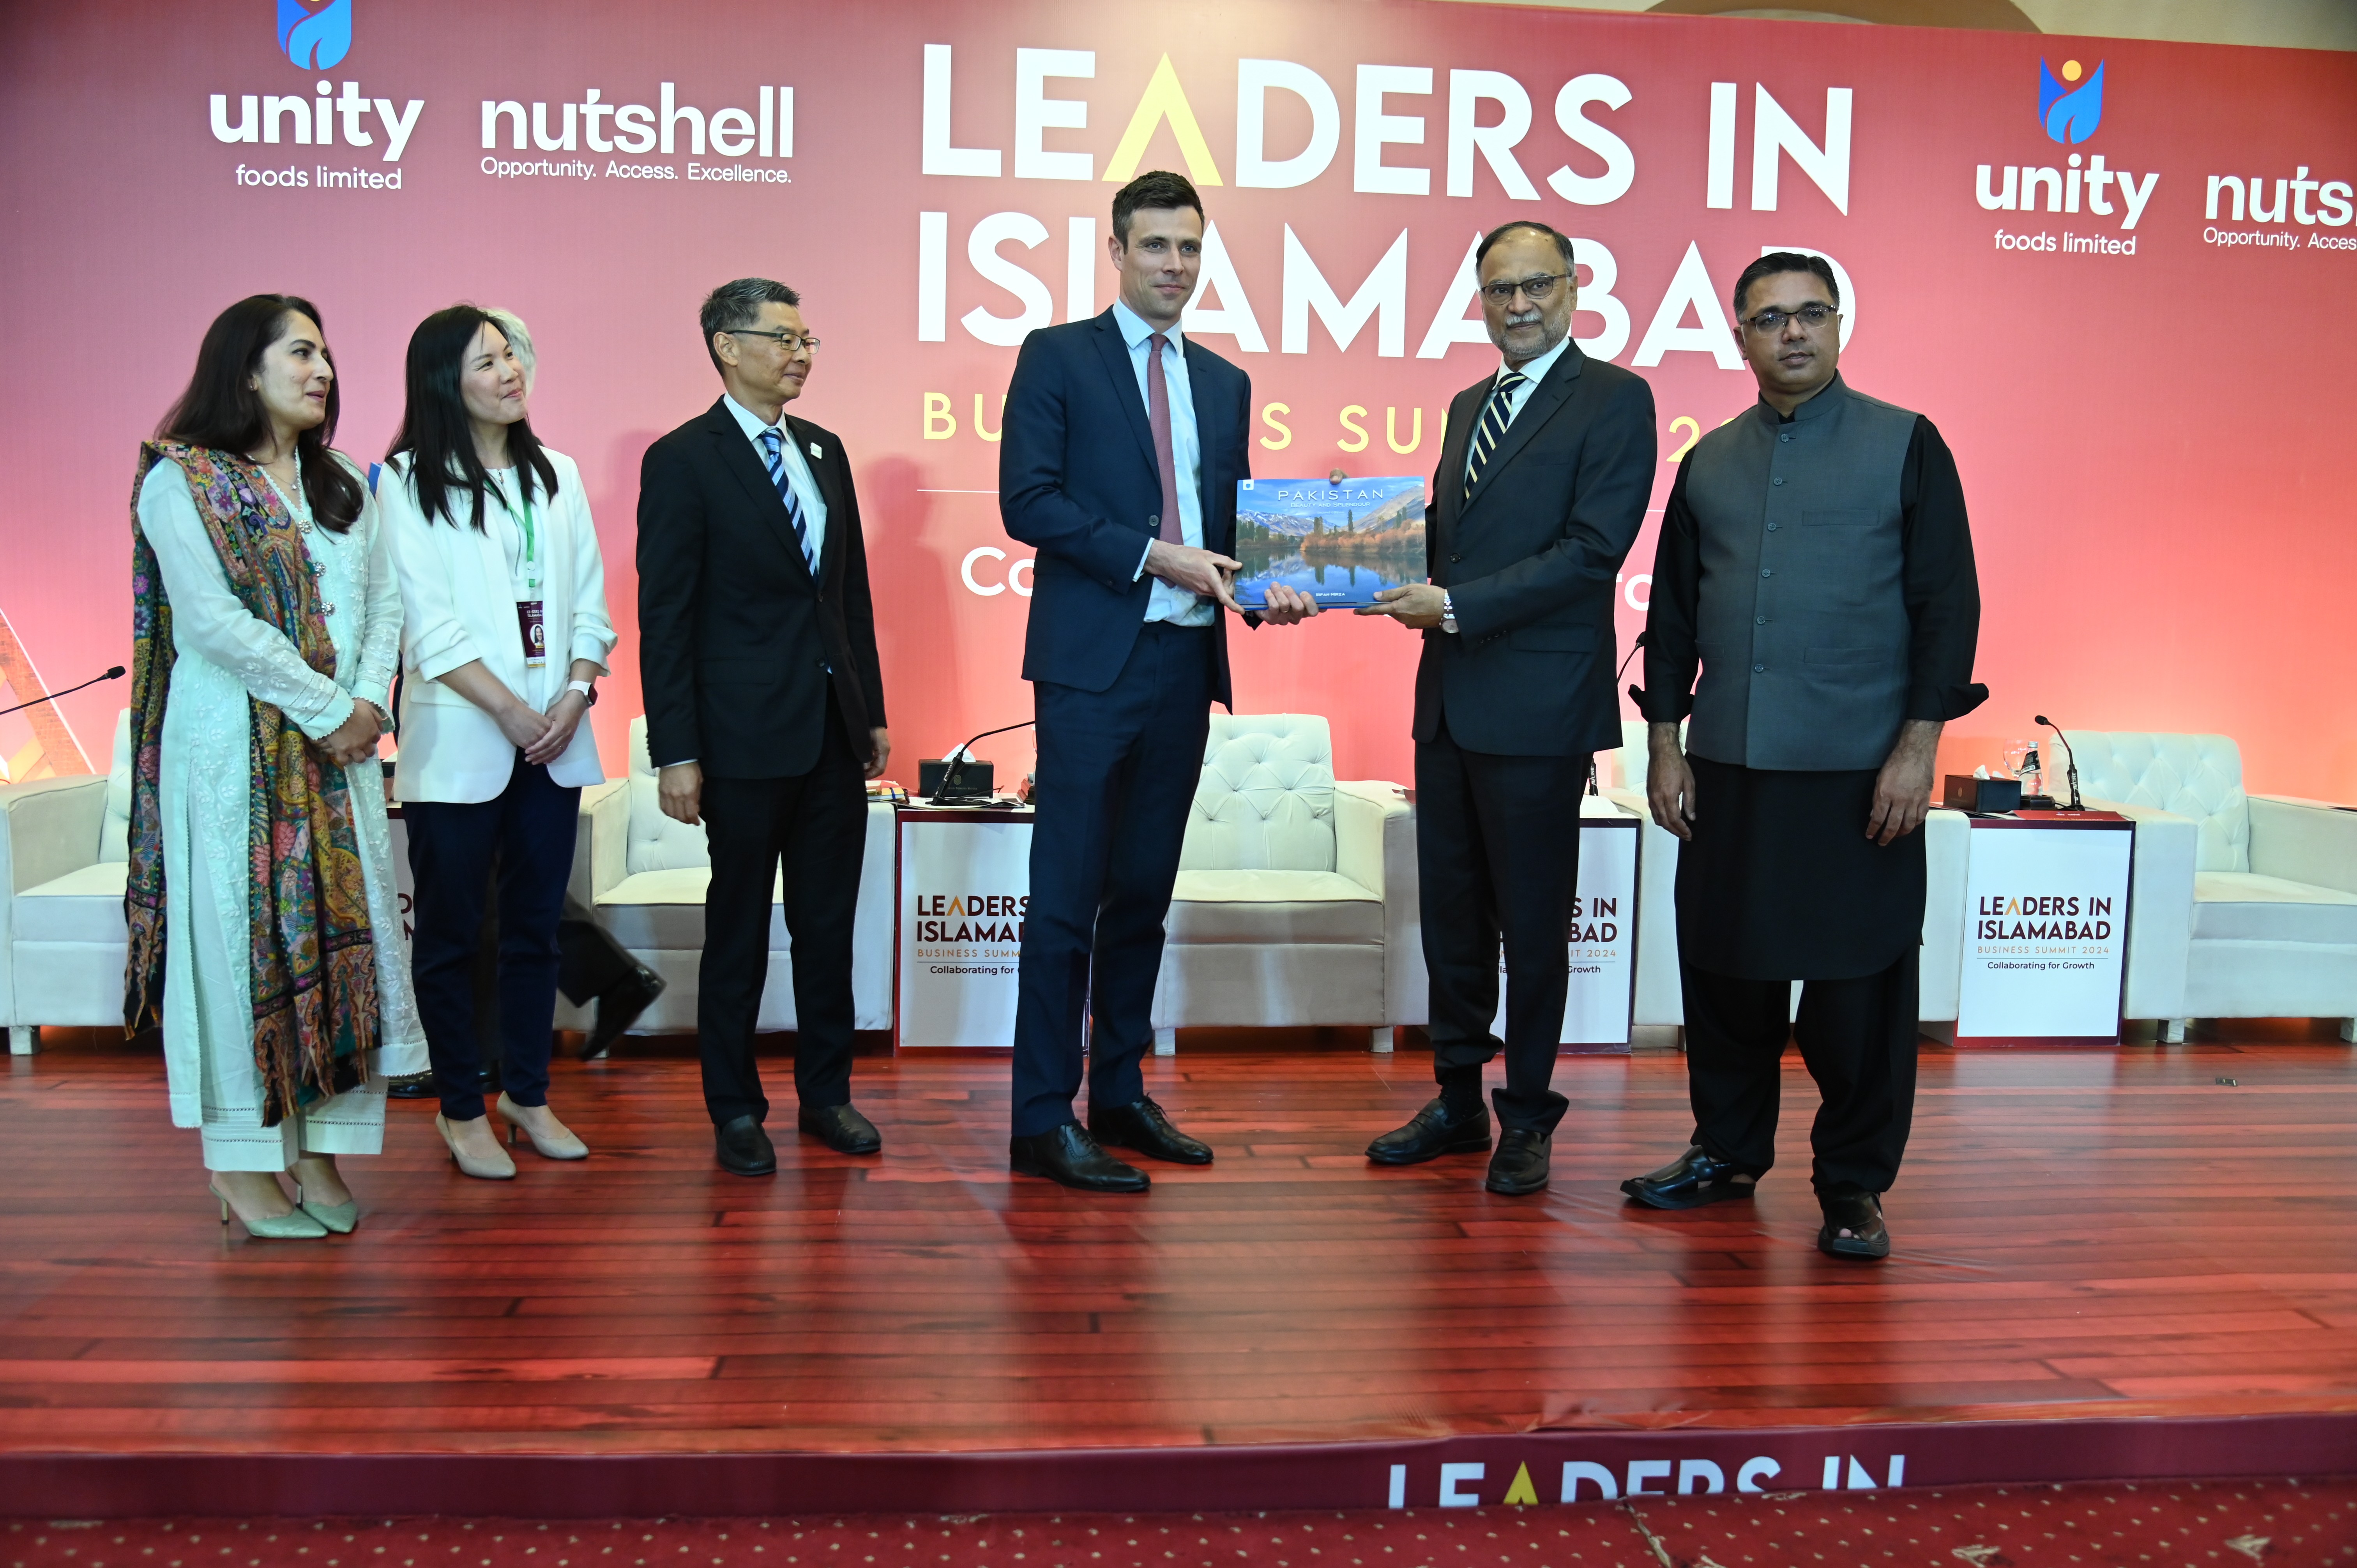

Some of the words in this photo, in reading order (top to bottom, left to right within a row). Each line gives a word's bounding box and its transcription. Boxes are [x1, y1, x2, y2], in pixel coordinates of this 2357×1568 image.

[210, 80, 425, 161] unity
[482, 82, 794, 158] nutshell
[922, 44, 1635, 206] LEADERS
[1707, 82, 1852, 216] IN
[236, 164, 309, 187] foods
[317, 165, 402, 189] limited
[481, 157, 596, 180] Opportunity.
[605, 160, 678, 180] Access.
[688, 162, 793, 183] Excellence.
[1976, 153, 2159, 230] unity
[2206, 166, 2357, 226] nuts
[1994, 229, 2056, 252] foods
[2063, 232, 2136, 255] limited
[2203, 227, 2300, 250] Opportunity.
[1278, 489, 1383, 501] PAKISTAN
[1593, 897, 1617, 918] IN
[1979, 896, 2079, 916] LEADERS
[2089, 897, 2111, 916] IN
[1978, 920, 2111, 940] ISLAMABAD
[918, 949, 977, 957] BUSINESS
[930, 965, 998, 975] Collaborating
[1000, 966, 1014, 974] for
[1987, 961, 2046, 971] Collaborating
